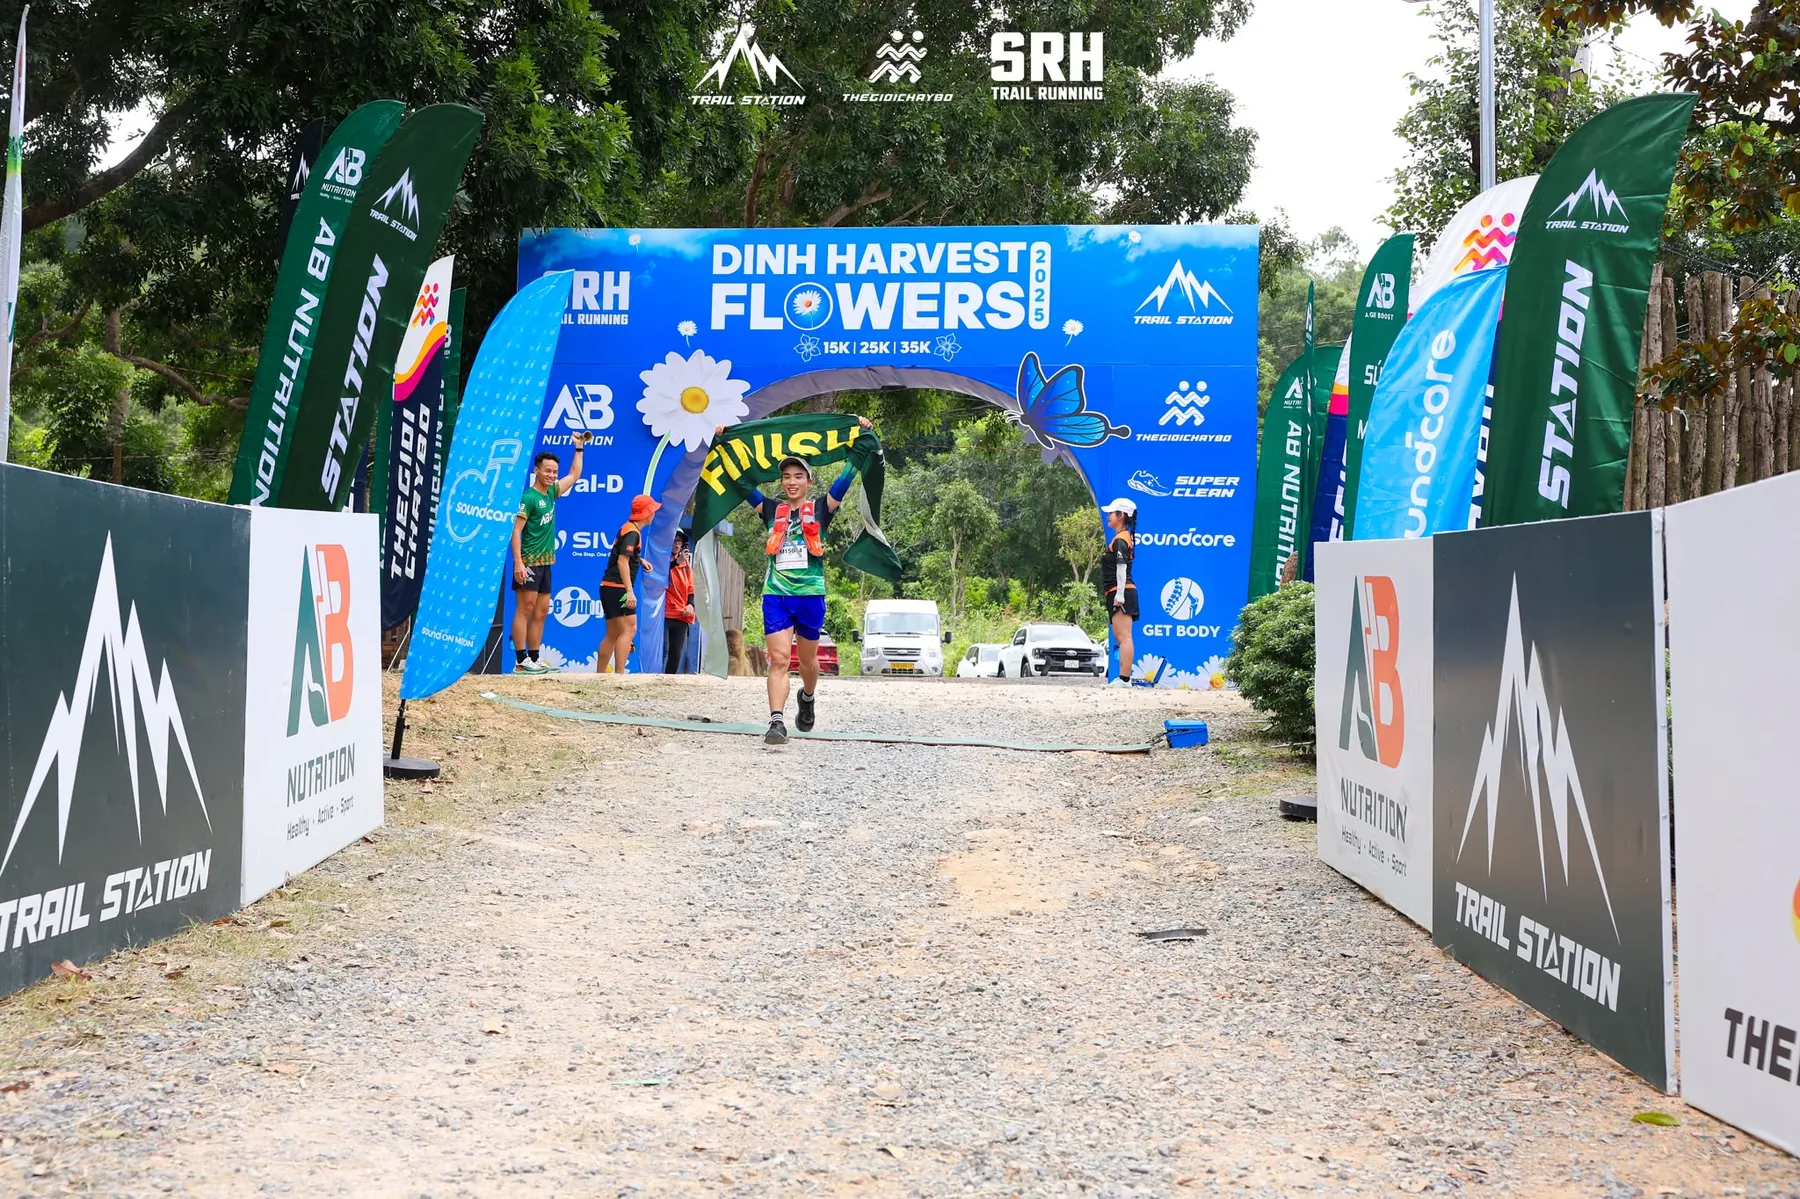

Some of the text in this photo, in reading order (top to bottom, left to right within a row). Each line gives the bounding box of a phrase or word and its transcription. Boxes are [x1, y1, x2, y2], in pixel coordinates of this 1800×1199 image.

[324, 146, 366, 186] AB
[320, 183, 357, 198] NUTRITION
[369, 208, 418, 242] TRAIL STATION
[1545, 220, 1630, 235] TRAIL STATION
[713, 241, 1027, 275] DINH HARVEST
[543, 270, 630, 310] RH
[1034, 248, 1047, 323] 2025
[1366, 273, 1395, 309] AB
[578, 314, 629, 325] RUNNING
[711, 281, 1026, 331] FLOWERS
[1134, 315, 1234, 325] TRAIL STATION
[249, 216, 336, 505] AB NUTRITION
[824, 341, 931, 354] 15K 25K 35K
[320, 253, 390, 504] STATION
[1537, 259, 1594, 510] STATION
[543, 384, 615, 430] AB
[542, 435, 614, 446] NUTION
[1285, 419, 1302, 458] AB
[1172, 487, 1235, 498] CLEAN
[1175, 475, 1240, 486] SUPER
[456, 501, 517, 524] soundcore
[1131, 527, 1236, 547] soundcore
[286, 543, 354, 737] AB
[1142, 624, 1221, 638] GET BODY
[1338, 575, 1405, 770] AB
[287, 742, 355, 807] NUTRITION
[287, 795, 354, 841] Healthy Active Sport
[1341, 776, 1407, 844] NUTRITION
[1341, 825, 1407, 877] Healthy Active Sport
[0, 848, 212, 953] TRAIL STATION
[1455, 882, 1621, 1014] TRAIL STATION
[1724, 1007, 1800, 1087] THE
